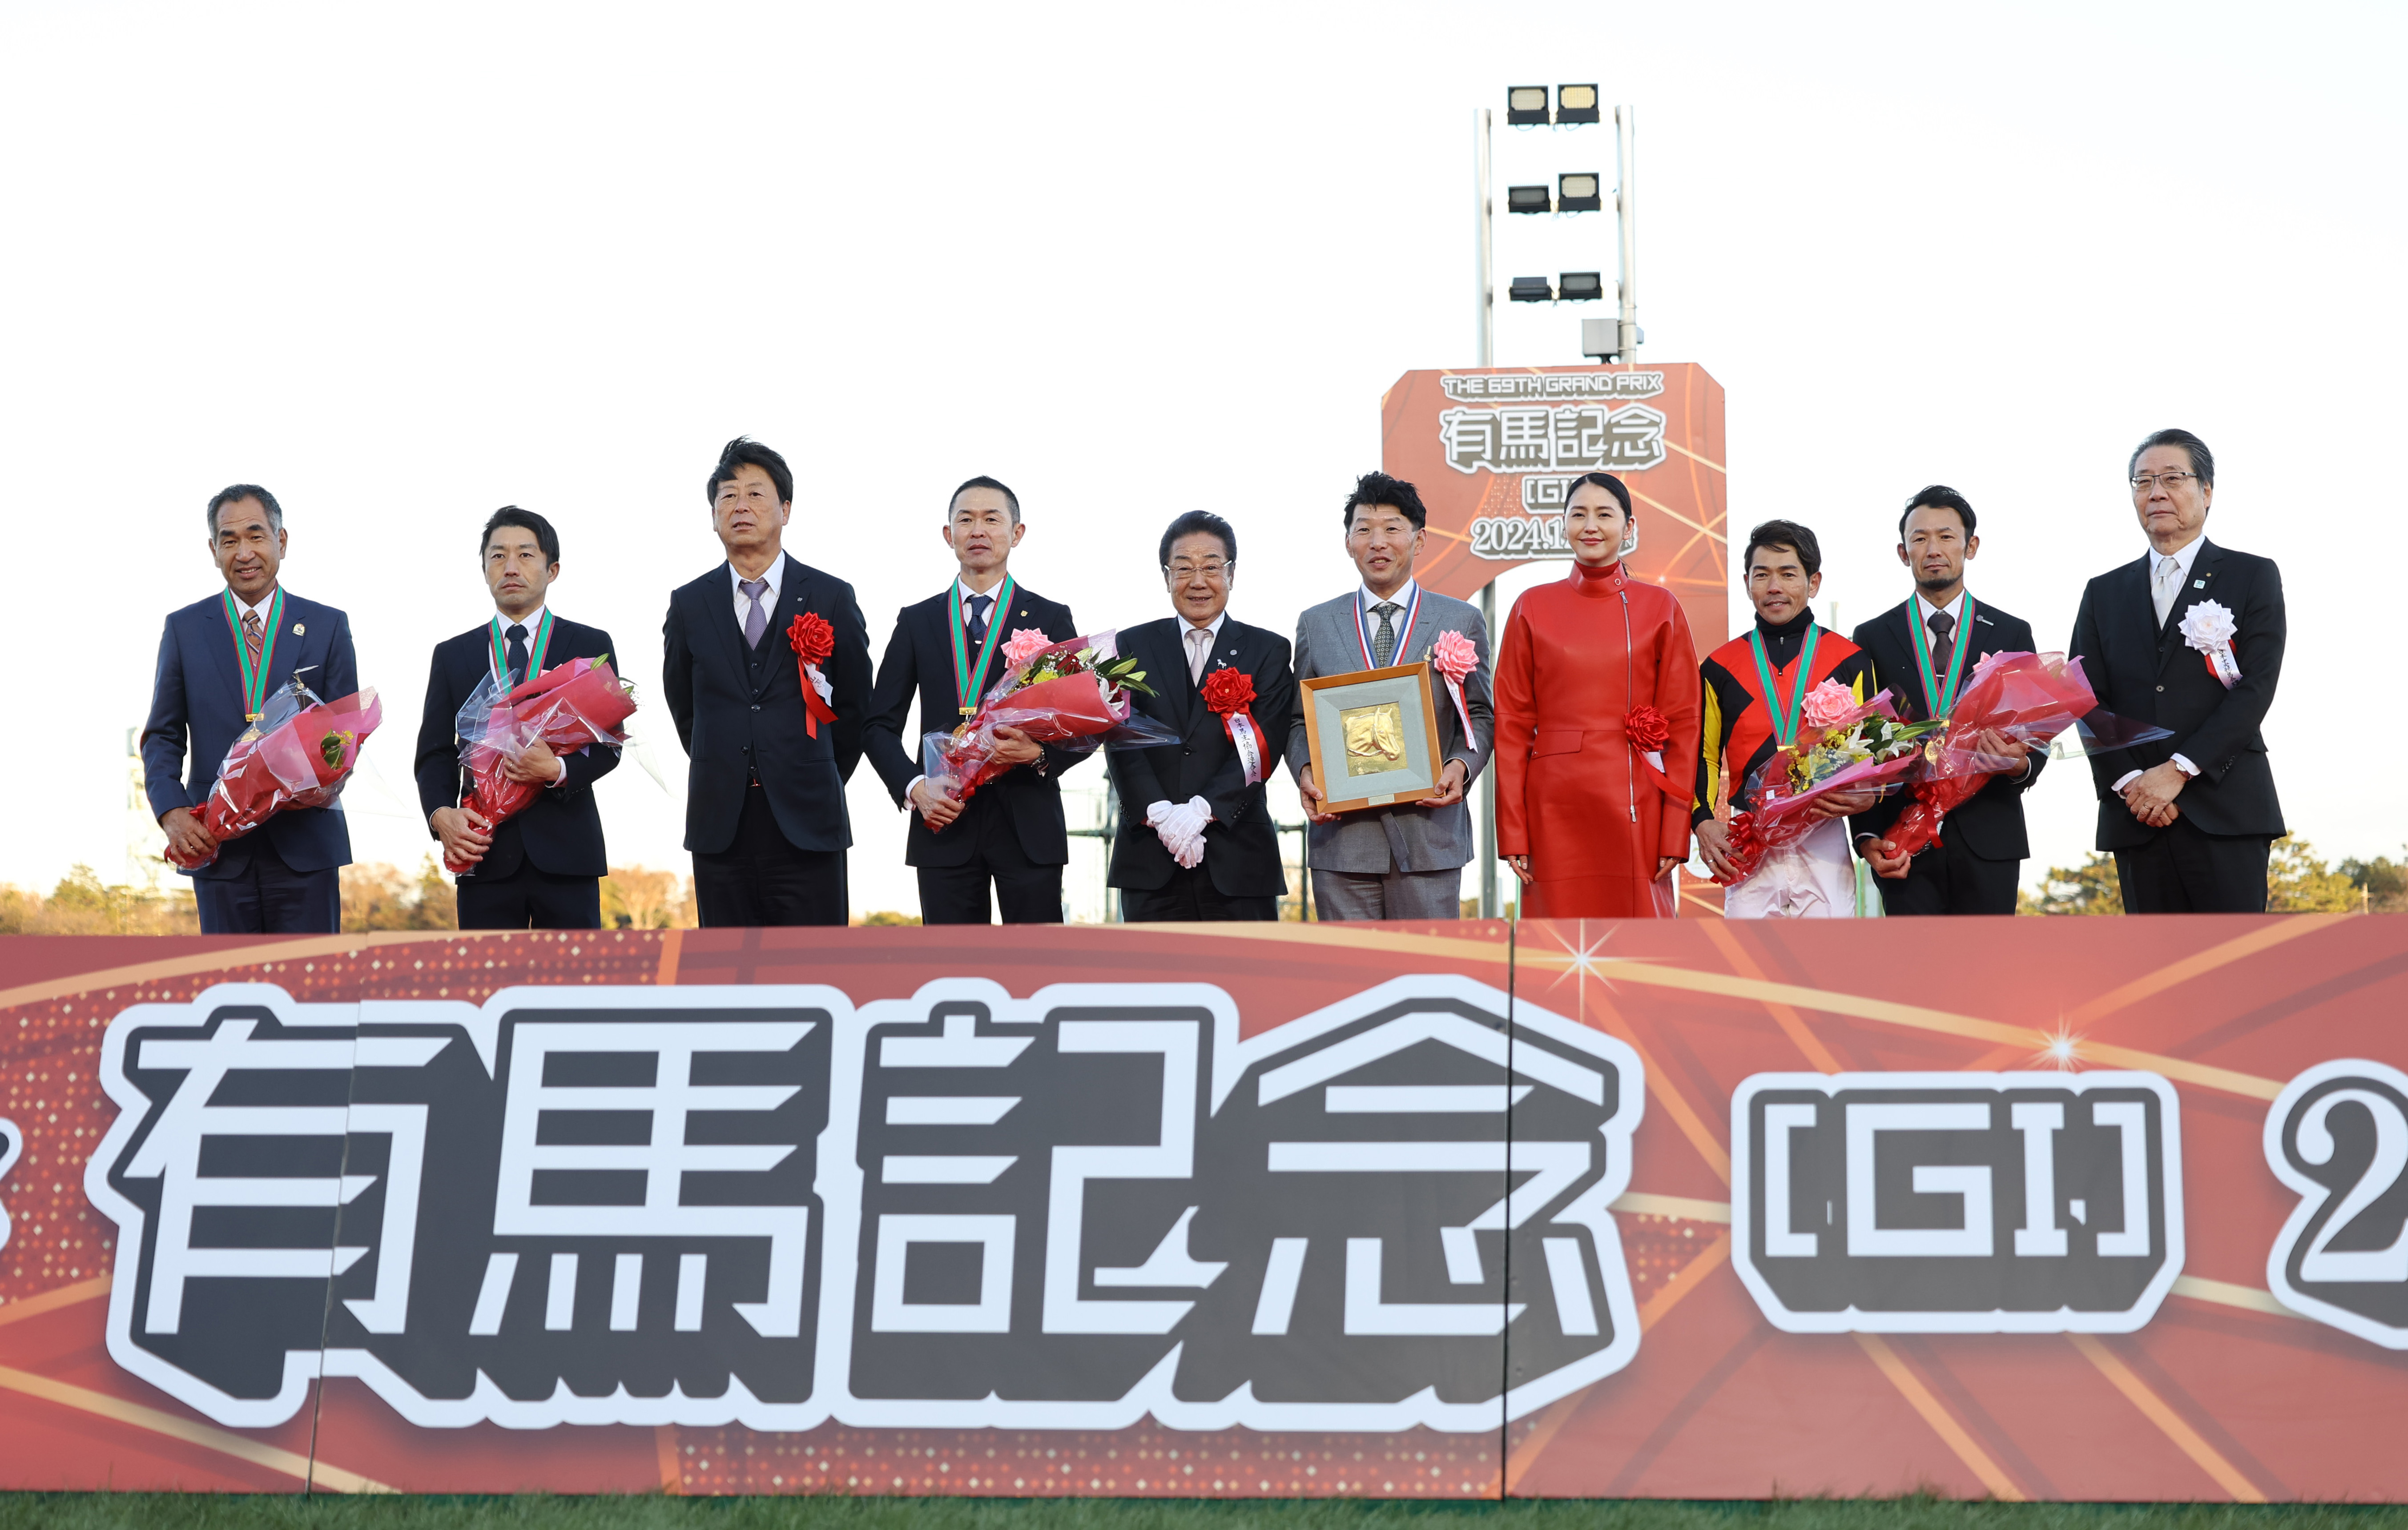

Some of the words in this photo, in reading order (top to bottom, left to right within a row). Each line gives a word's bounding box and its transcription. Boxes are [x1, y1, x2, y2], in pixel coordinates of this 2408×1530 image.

[1444, 378, 1484, 394] THE
[1488, 376, 1542, 394] 69TH
[1545, 375, 1612, 392] GRAND
[1616, 374, 1661, 391] PRIX
[1444, 406, 1661, 461] 有馬記念
[1526, 478, 1574, 503] [GI
[121, 1009, 1607, 1338] 有馬記念
